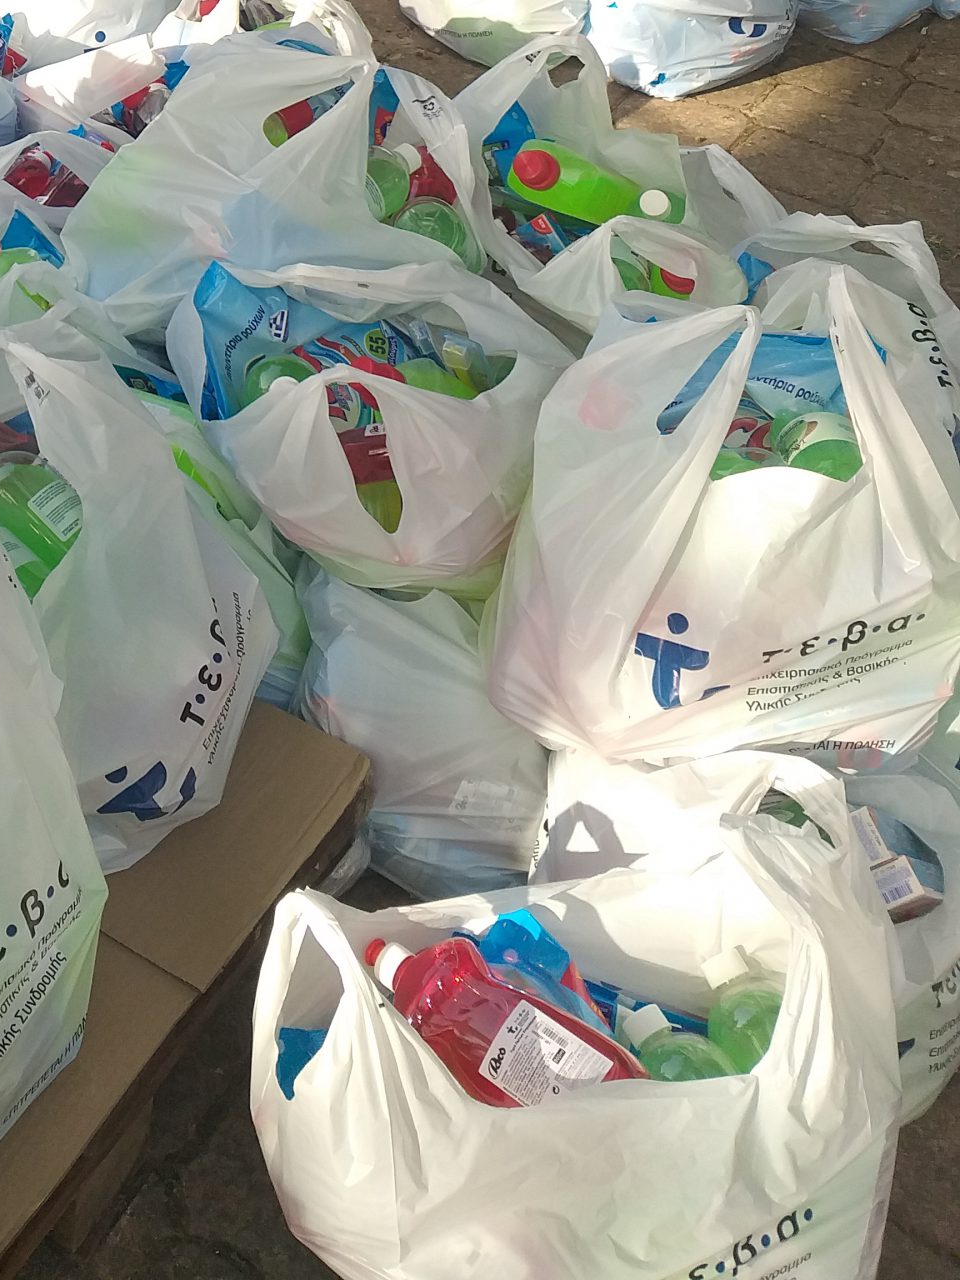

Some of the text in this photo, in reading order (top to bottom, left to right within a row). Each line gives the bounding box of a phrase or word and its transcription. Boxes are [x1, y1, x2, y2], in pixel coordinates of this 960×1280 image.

[240, 304, 266, 343] ρούχων
[368, 336, 387, 355] 55
[845, 639, 913, 665] Πρόγραμμα
[832, 670, 845, 680] &
[844, 739, 896, 751] ΠΩΛΗΣΗ
[14, 950, 68, 1025] Συνδρομής
